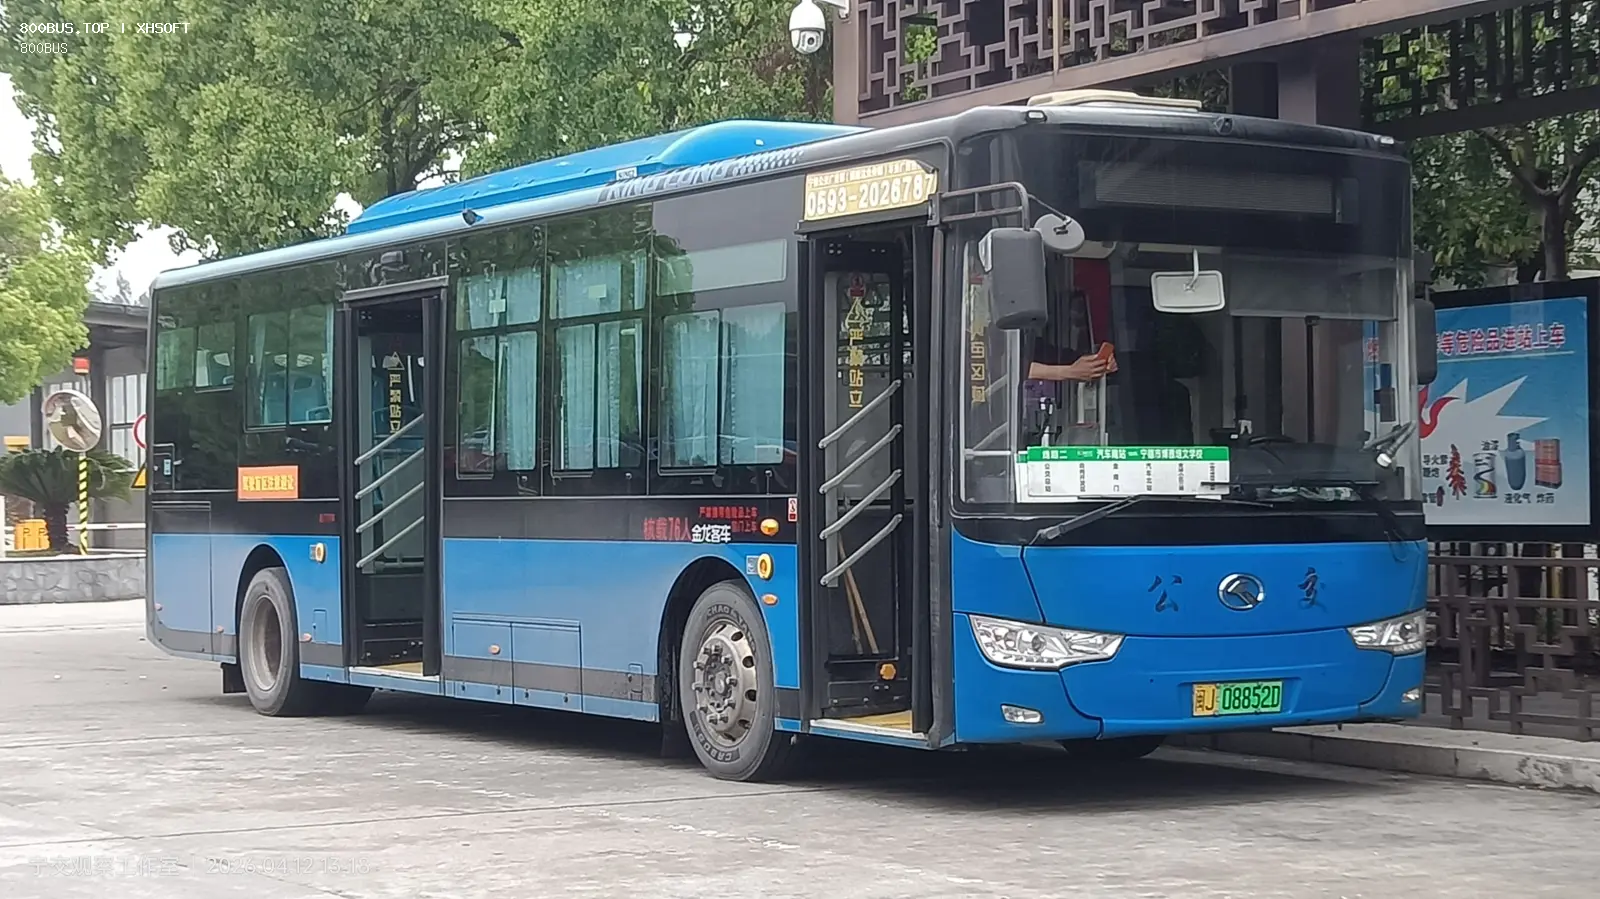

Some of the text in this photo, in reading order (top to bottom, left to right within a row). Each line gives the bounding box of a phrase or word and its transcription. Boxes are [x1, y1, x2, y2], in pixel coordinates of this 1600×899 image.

[1437, 321, 1565, 357] 等危险品进站上车
[691, 523, 732, 543] 金龙客车
